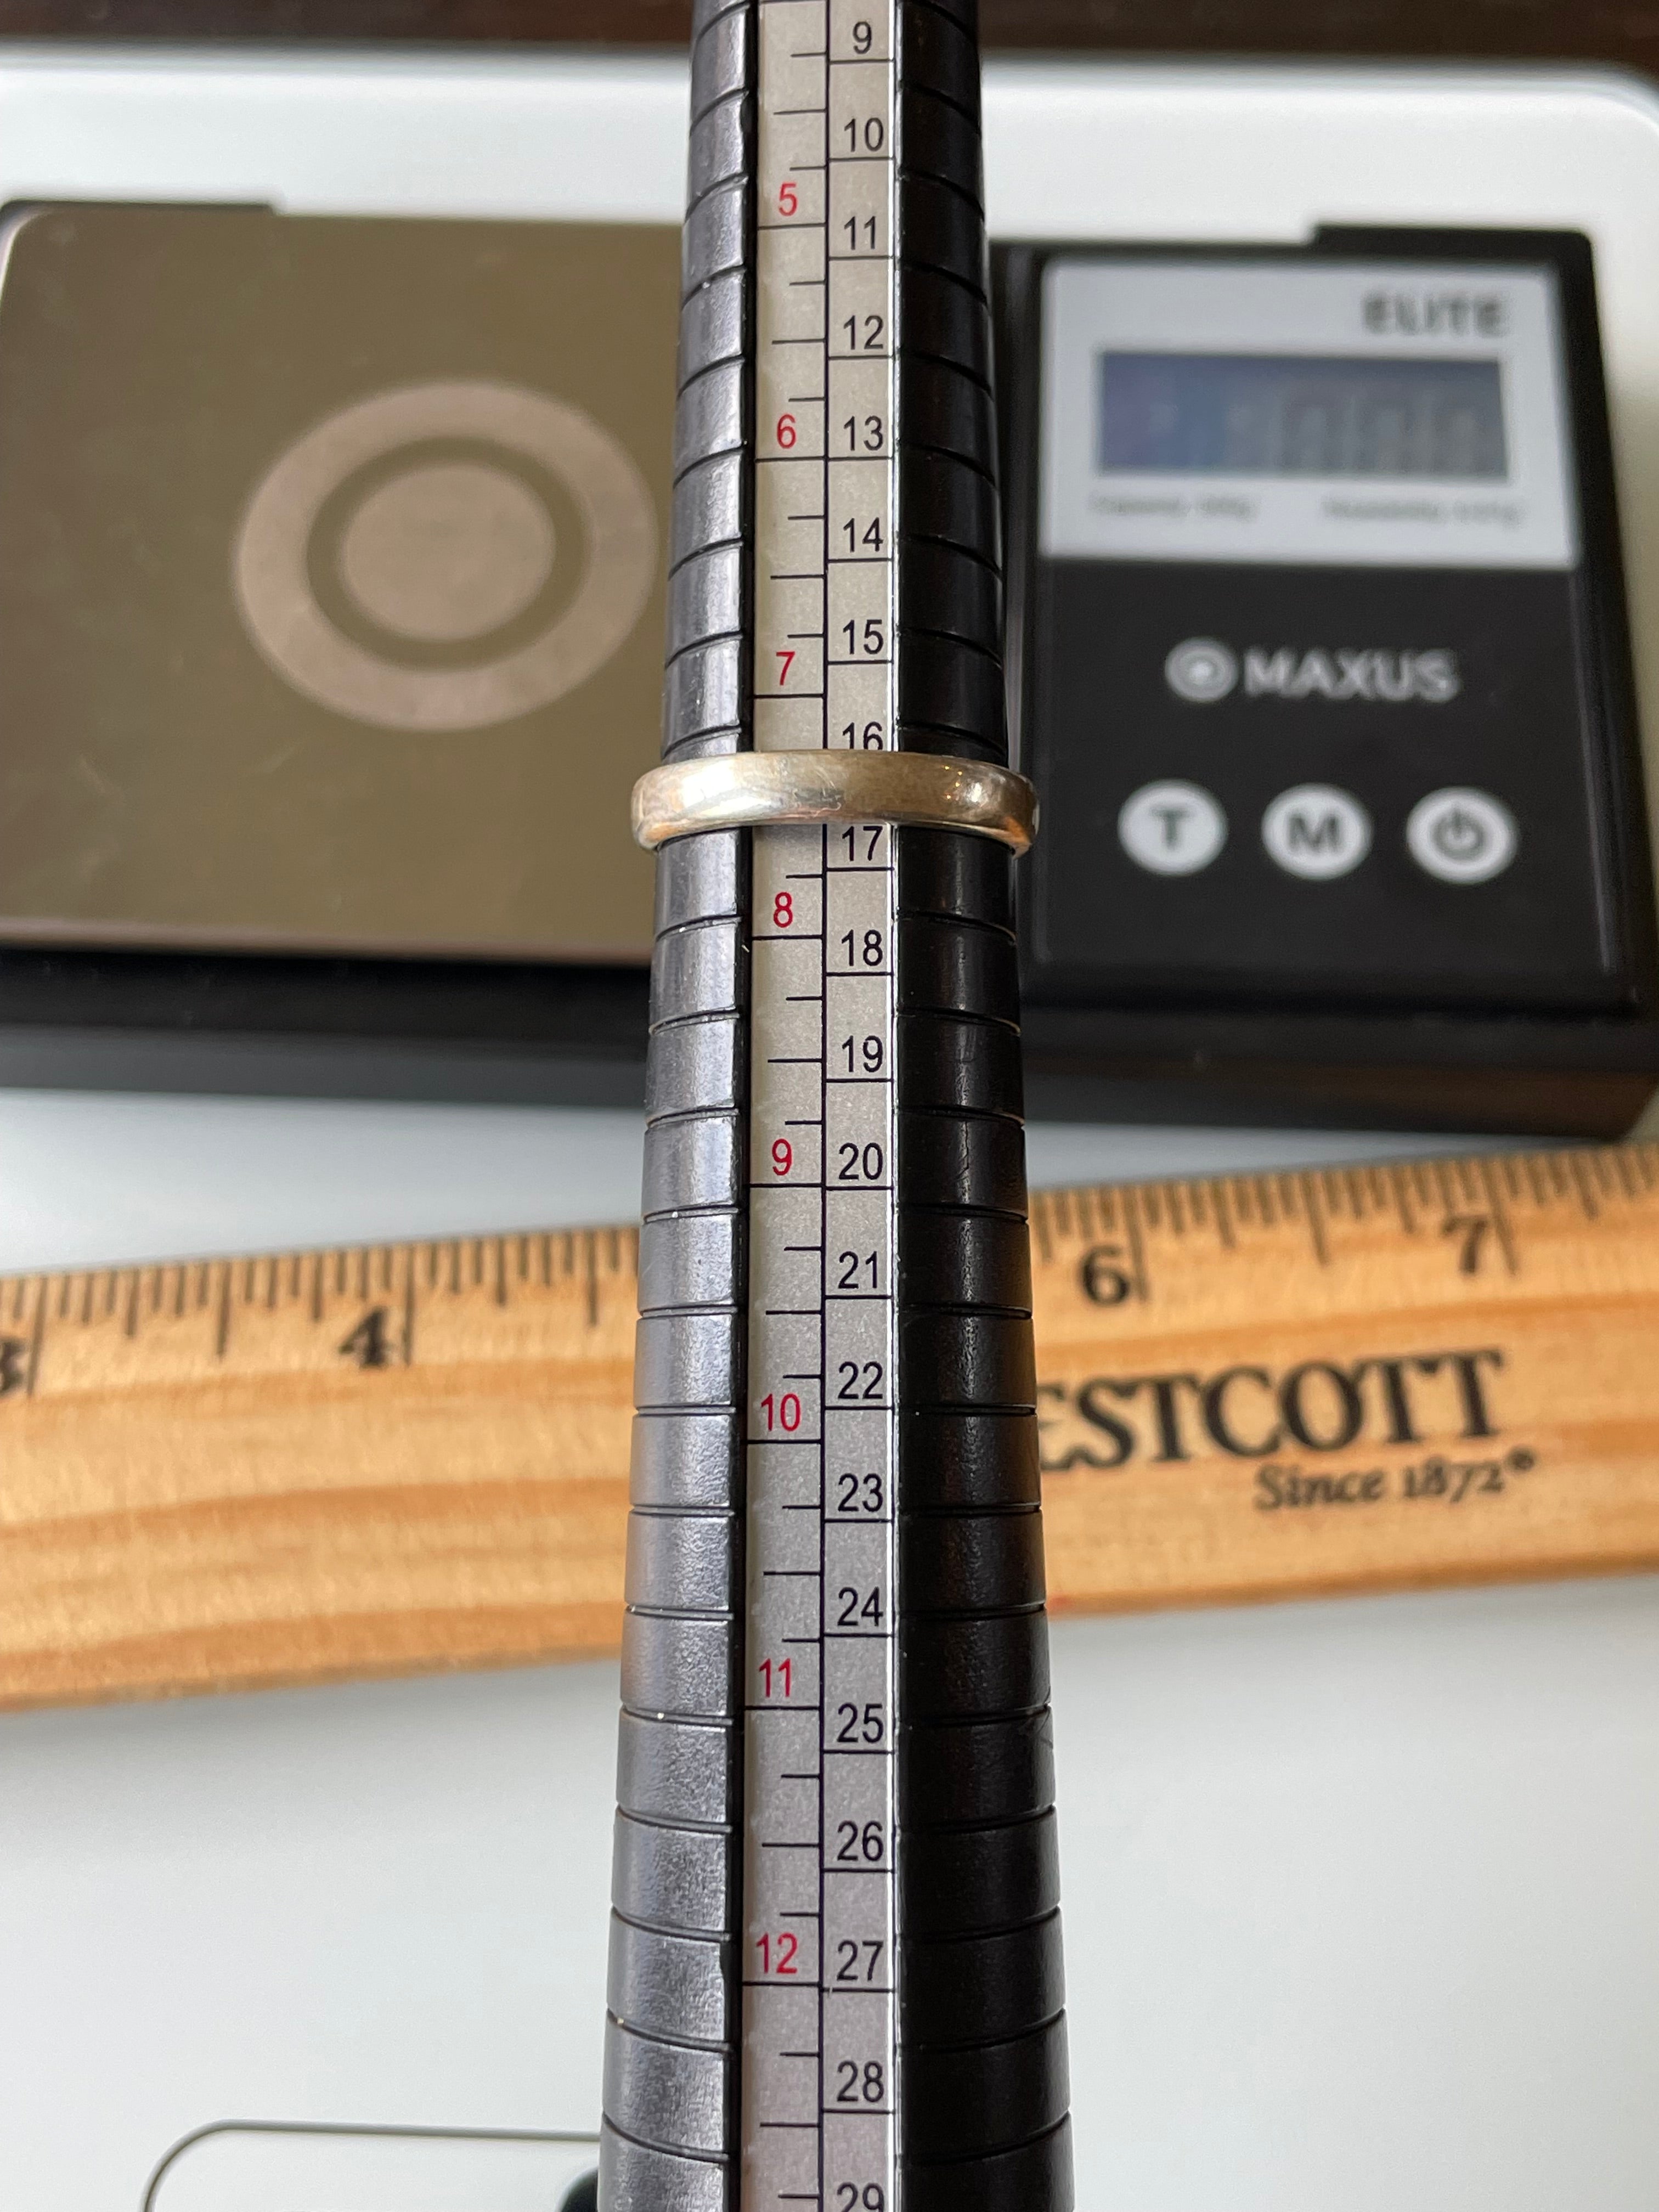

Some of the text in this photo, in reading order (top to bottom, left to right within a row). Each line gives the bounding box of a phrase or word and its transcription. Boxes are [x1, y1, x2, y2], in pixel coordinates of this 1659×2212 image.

[853, 20, 872, 55] 9
[844, 117, 884, 153] 10
[778, 182, 798, 216] 5
[844, 215, 876, 251] 11
[843, 315, 884, 350] 12
[1362, 291, 1505, 335] ELITE
[776, 414, 797, 449] 6
[843, 415, 883, 452] 13
[843, 517, 884, 552] 14
[843, 619, 884, 655] 15
[776, 651, 796, 686] 7
[1243, 647, 1460, 703] MAXUS
[842, 721, 883, 750] 16
[842, 825, 883, 861] 17
[1150, 807, 1188, 850] T
[1287, 812, 1339, 853] M
[773, 891, 794, 929] 8
[841, 929, 883, 967] 18
[842, 1035, 884, 1073] 19
[771, 1138, 793, 1176] 9
[838, 1142, 884, 1181] 20
[1442, 1214, 1488, 1275] 7
[837, 1250, 878, 1289] 21
[1079, 1245, 1130, 1306] 6
[337, 1306, 396, 1369] 4
[837, 1361, 883, 1401] 22
[761, 1393, 802, 1432] 10
[837, 1472, 884, 1513] 23
[1255, 1462, 1386, 1511] Since
[837, 1586, 884, 1628] 24
[759, 1658, 792, 1697] 11
[836, 1702, 884, 1745] 25
[837, 1820, 884, 1863] 26
[757, 1932, 798, 1975] 12
[836, 1939, 884, 1982] 27
[836, 2060, 884, 2103] 28
[836, 2182, 885, 2212] 29
